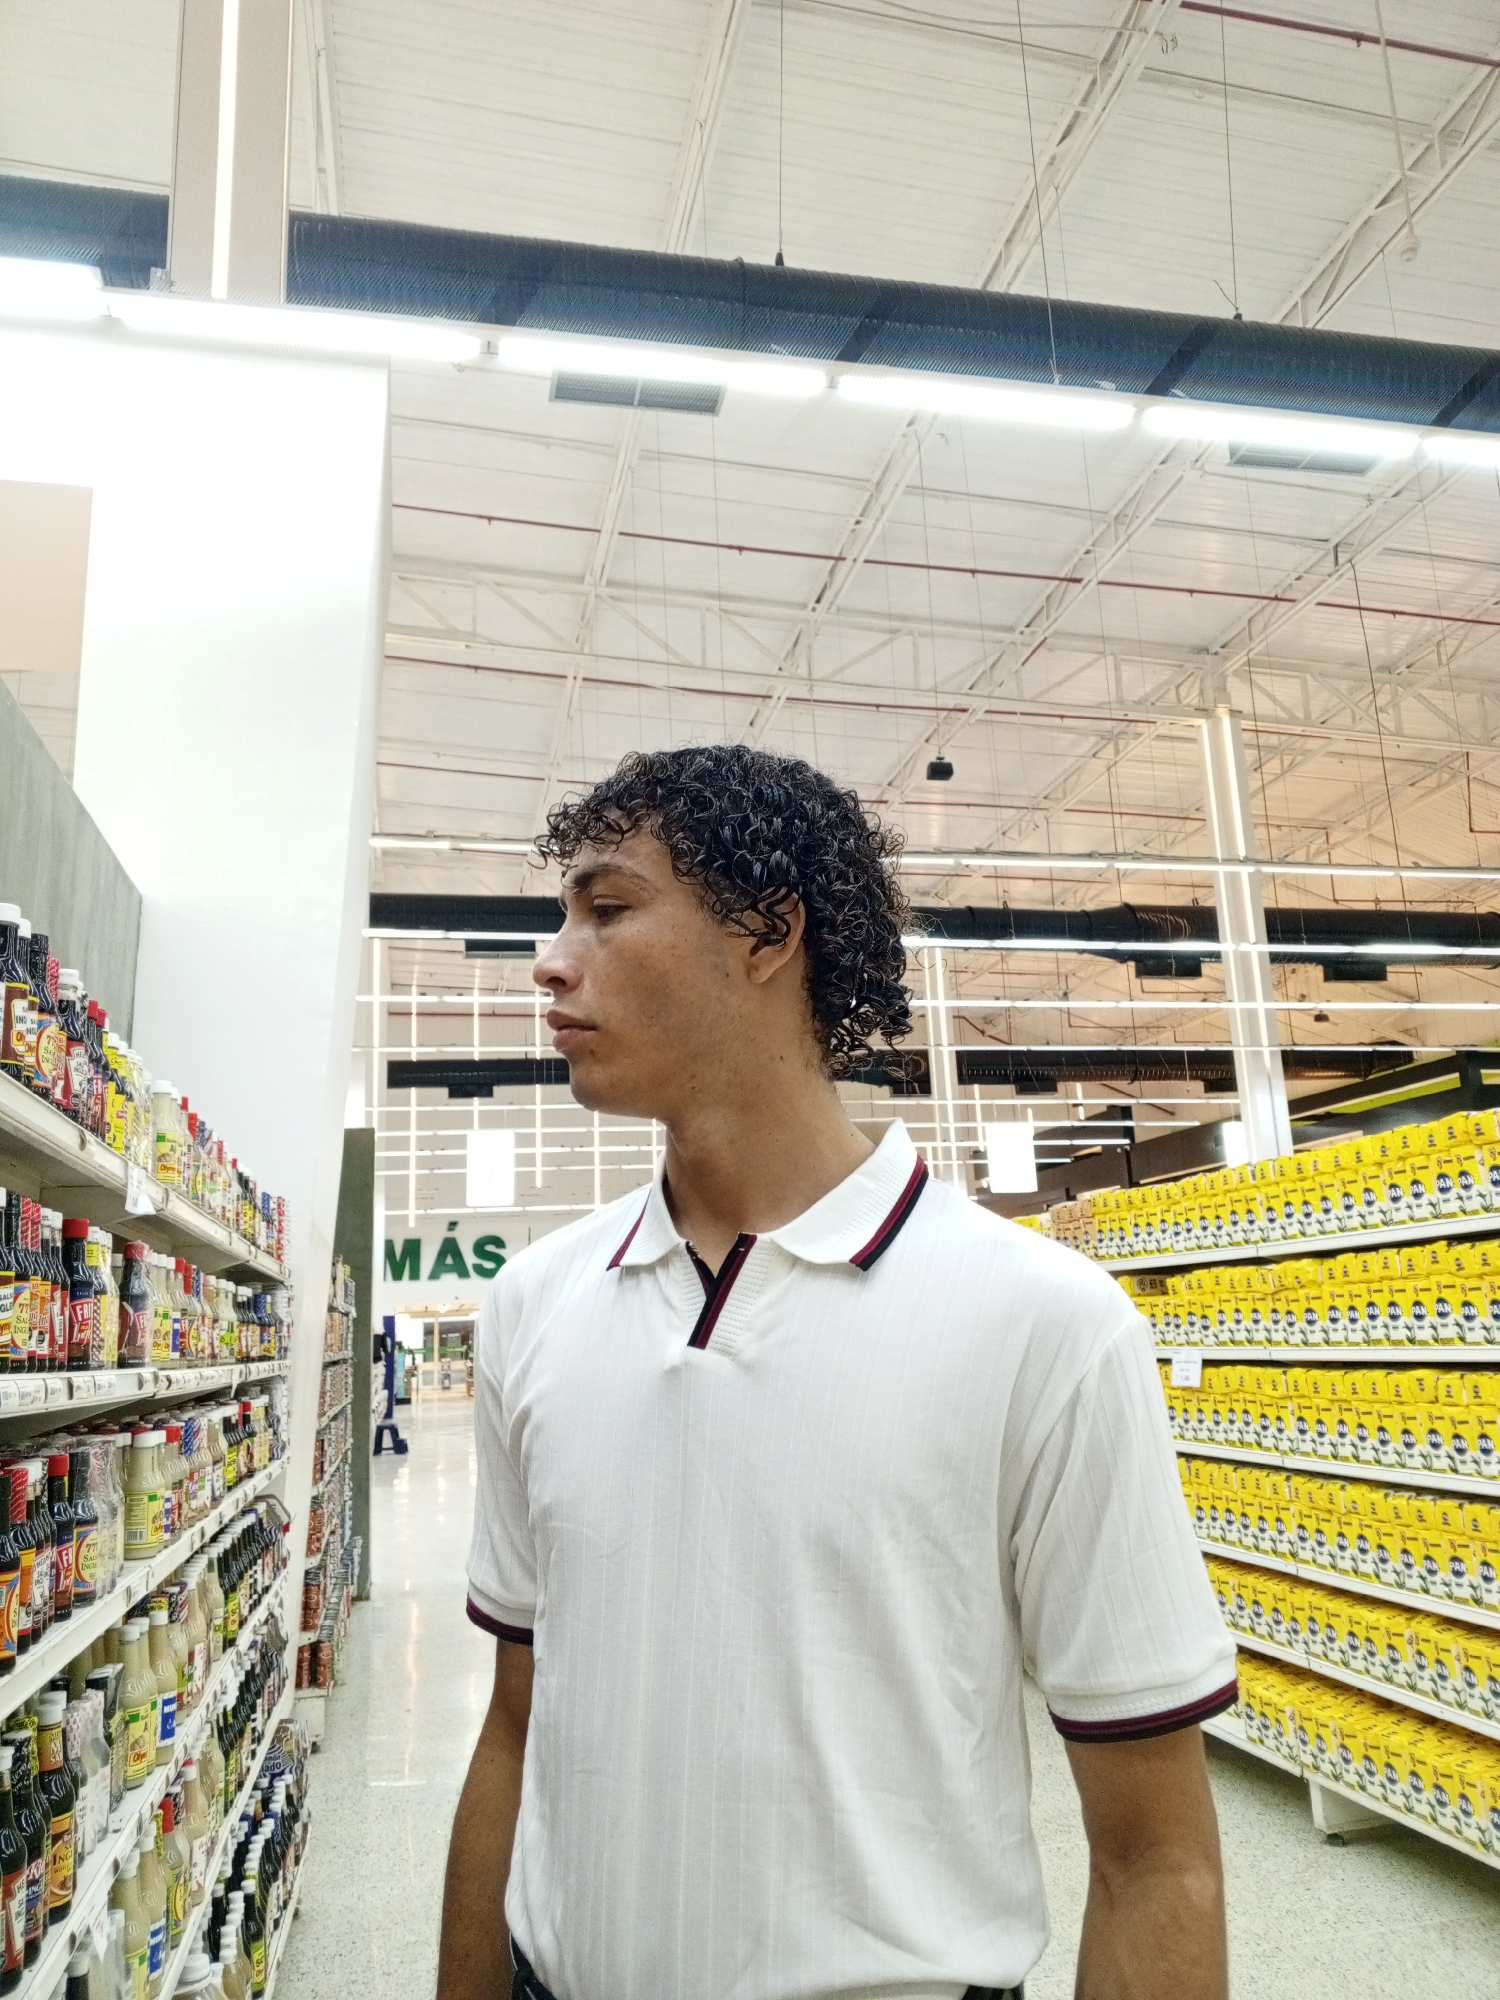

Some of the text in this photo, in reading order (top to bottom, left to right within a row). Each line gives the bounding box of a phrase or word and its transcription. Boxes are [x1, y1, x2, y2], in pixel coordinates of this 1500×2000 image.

[1489, 1170, 1500, 1180] PA
[1437, 1178, 1454, 1189] PAN
[1459, 1176, 1474, 1186] PAN
[1389, 1187, 1403, 1198] PAN
[1410, 1183, 1425, 1194] PAN
[1363, 1191, 1376, 1203] PAN
[384, 1221, 506, 1281] MÁS
[1366, 1306, 1380, 1315] PAN
[1388, 1306, 1402, 1316] PAN
[1412, 1306, 1427, 1316] PAN
[1435, 1303, 1452, 1313] PAN
[1461, 1306, 1477, 1316] PAN
[1490, 1305, 1500, 1315] PA
[1286, 1315, 1297, 1324] PAN
[1304, 1312, 1318, 1321] PAN
[1328, 1310, 1342, 1320] PAN
[1347, 1311, 1360, 1320] PAN
[1296, 1422, 1308, 1431] PAN
[1315, 1424, 1327, 1434] PAN
[1337, 1424, 1348, 1434] PAN
[1356, 1428, 1369, 1438] PAN
[1377, 1431, 1391, 1442] PAN
[1402, 1434, 1416, 1444] PAN
[1427, 1434, 1443, 1445] PAN
[1452, 1438, 1468, 1449] PAN
[1478, 1439, 1494, 1449] PAN
[1297, 1529, 1309, 1540] PAN
[1314, 1533, 1326, 1544] PAN
[1336, 1537, 1348, 1548] PAN
[1356, 1540, 1370, 1551] PAN
[1377, 1549, 1390, 1561] PAN
[1401, 1554, 1415, 1567] PAN
[1424, 1559, 1439, 1572] PAN
[81, 1563, 97, 1571] INGLE
[1449, 1562, 1466, 1573] PAN
[1480, 1566, 1496, 1578] PAN
[1490, 1812, 1500, 1826] PA
[53, 1850, 72, 1867] INGL
